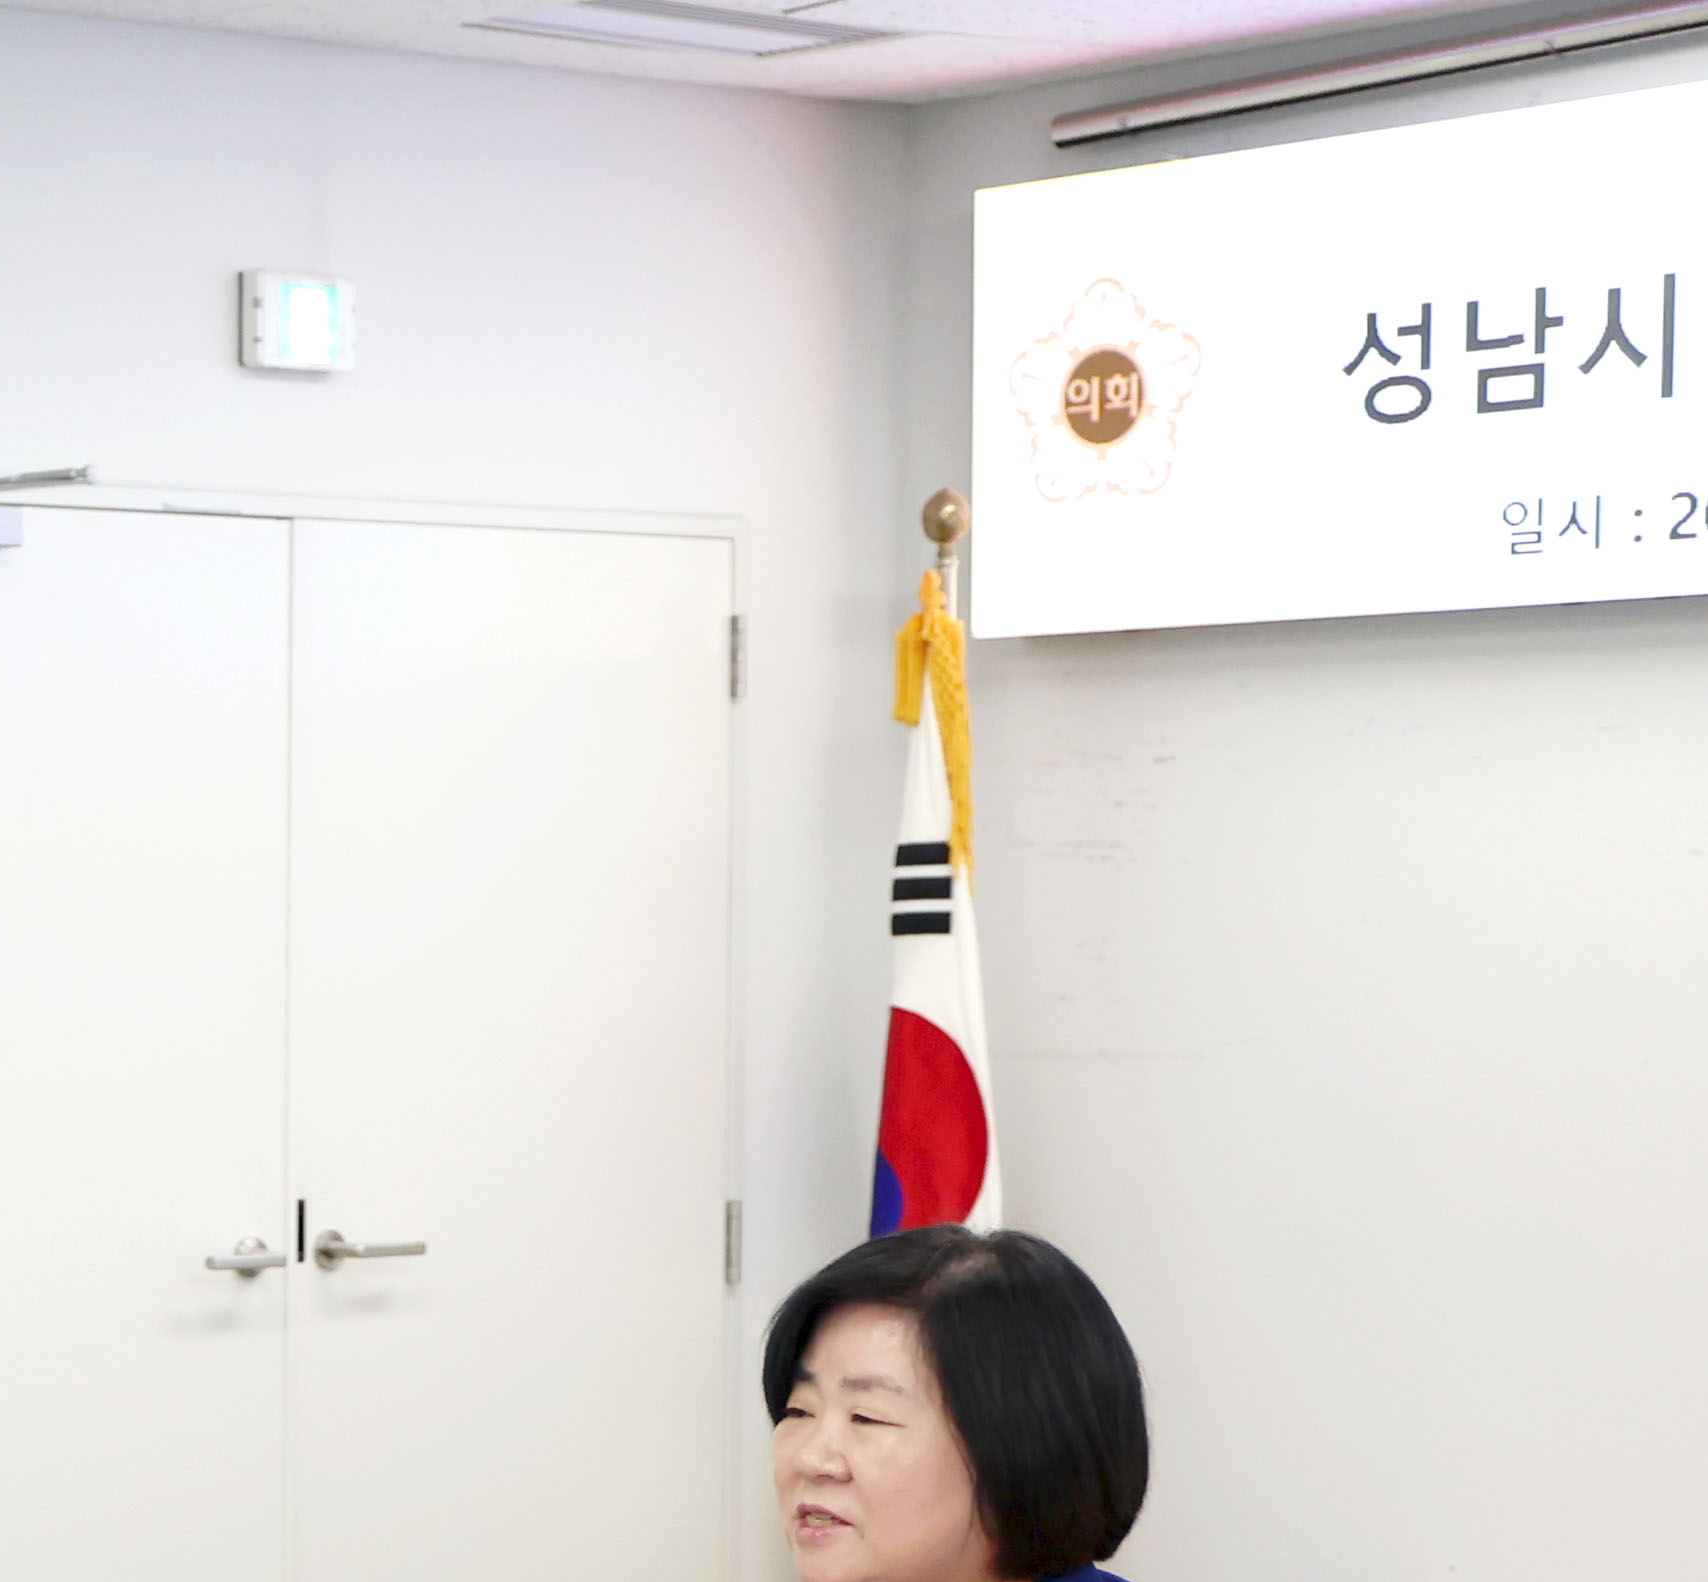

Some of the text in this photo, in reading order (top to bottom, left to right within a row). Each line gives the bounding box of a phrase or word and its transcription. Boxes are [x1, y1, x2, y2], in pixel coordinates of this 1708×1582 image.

[1342, 272, 1677, 425] 성남시
[1066, 371, 1139, 424] 의회
[1502, 494, 1601, 556] 일시
[1668, 491, 1708, 541] 2
